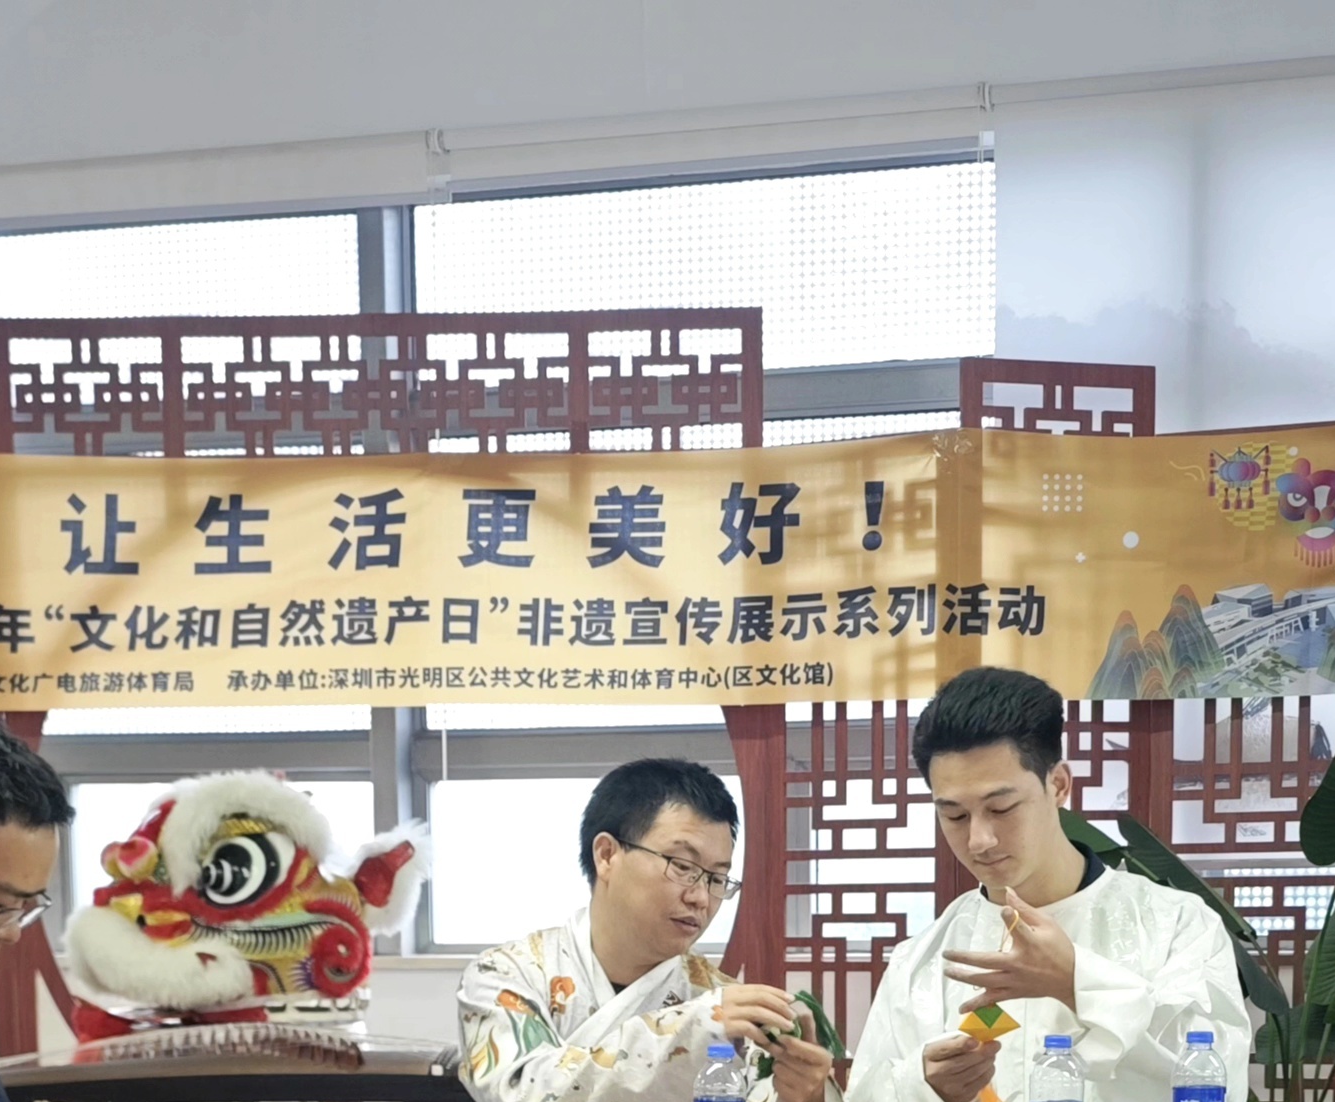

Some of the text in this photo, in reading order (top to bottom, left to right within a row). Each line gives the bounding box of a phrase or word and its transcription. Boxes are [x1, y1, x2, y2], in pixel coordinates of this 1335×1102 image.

[226, 660, 835, 691] 承办单位:深圳市光明区公共文化艺术和体育中心(区文化馆)
